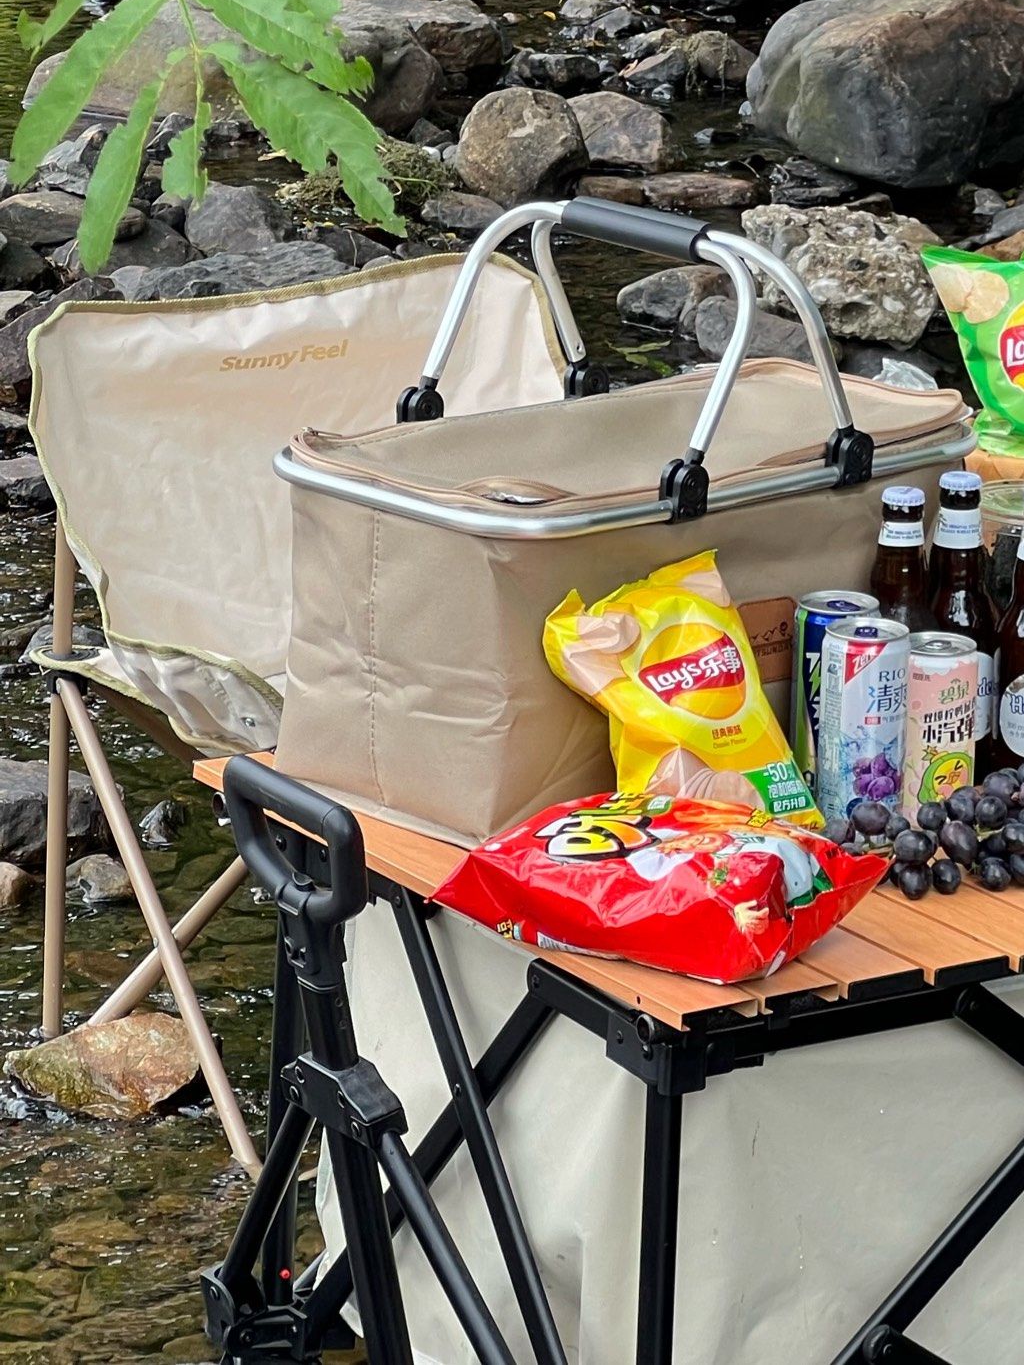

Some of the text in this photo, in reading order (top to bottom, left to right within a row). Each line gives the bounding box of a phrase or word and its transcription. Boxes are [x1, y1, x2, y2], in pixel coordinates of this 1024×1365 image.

[646, 644, 742, 693] Lay's 乐事
[879, 667, 906, 683] RIO
[866, 683, 908, 714] 清爽
